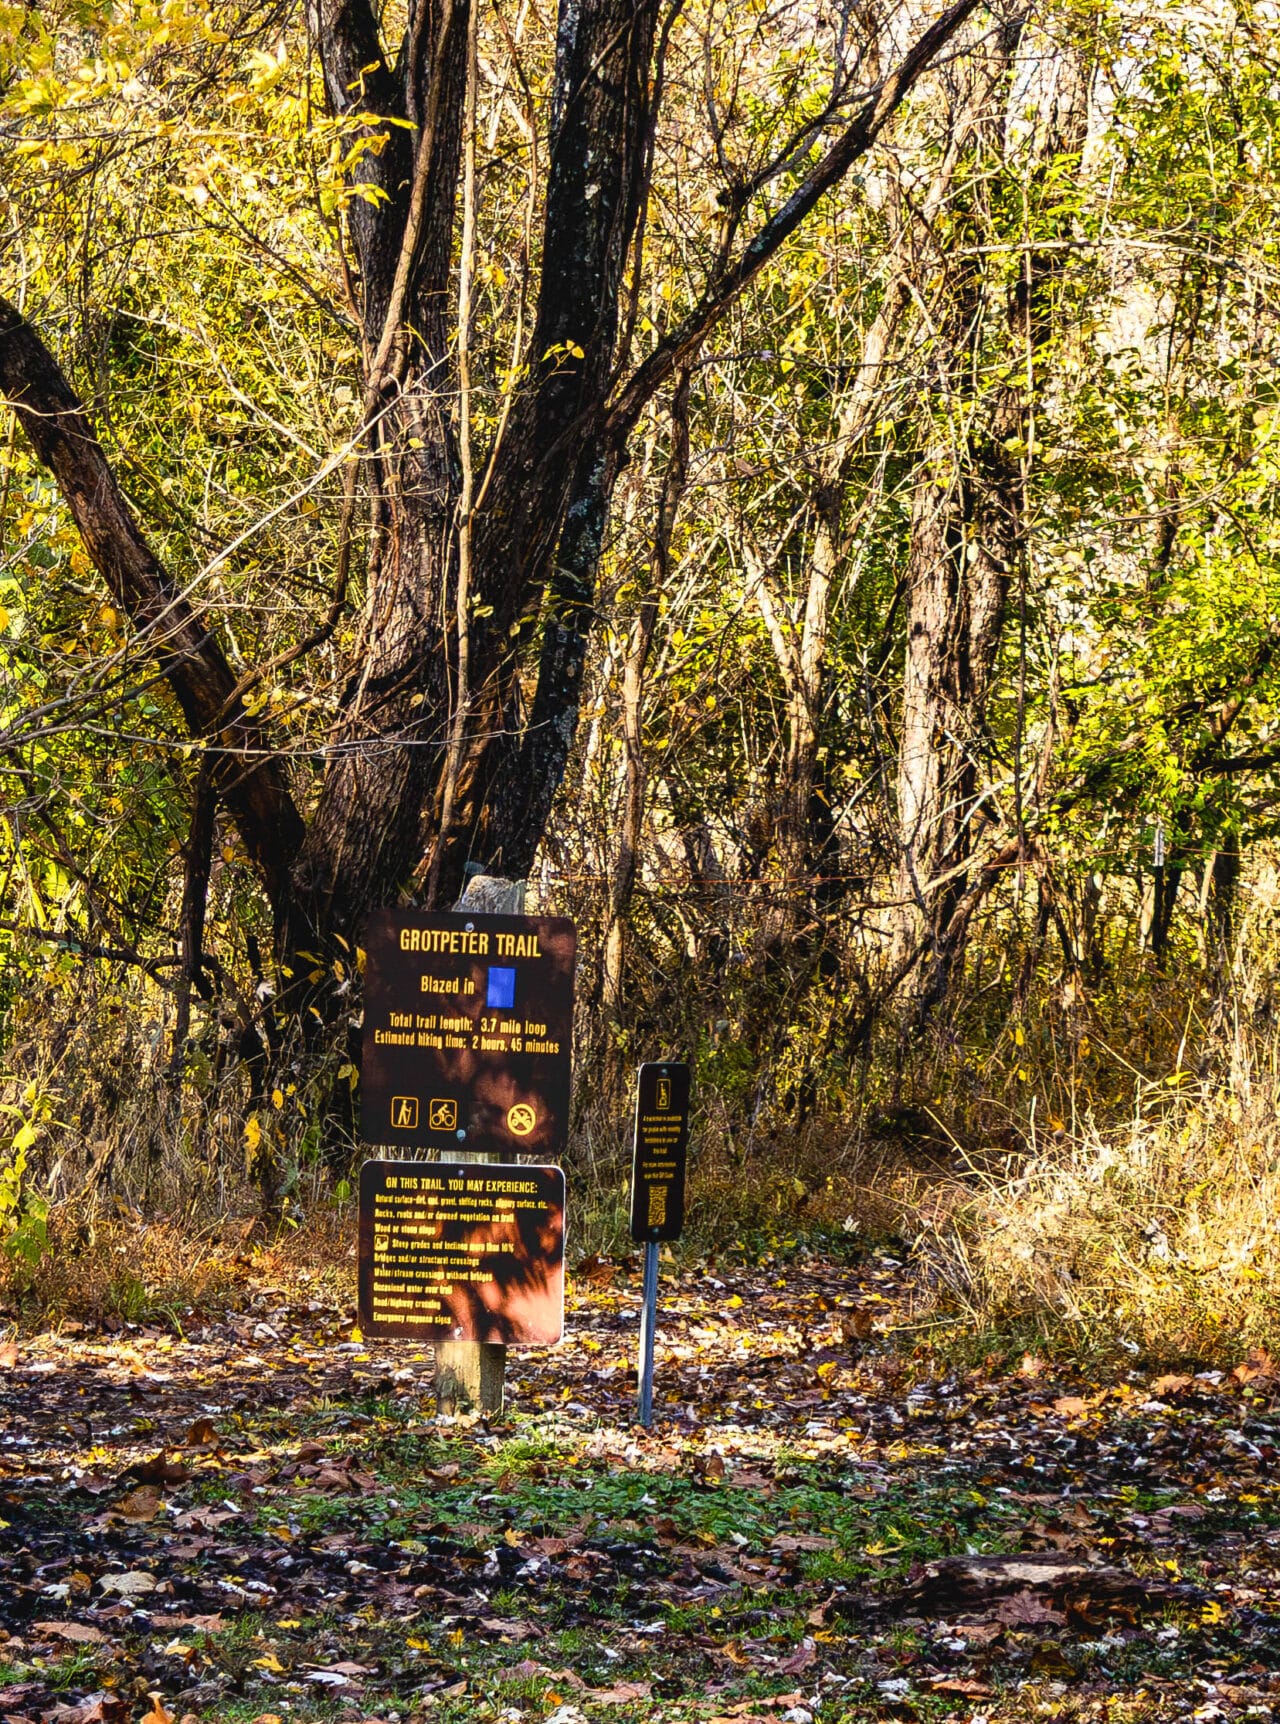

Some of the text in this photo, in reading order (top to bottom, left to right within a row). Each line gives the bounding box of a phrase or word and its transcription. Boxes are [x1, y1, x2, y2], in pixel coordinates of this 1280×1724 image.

[400, 929, 542, 958] GROTPETER TRAIL
[421, 975, 475, 995] Blazed in
[389, 1012, 547, 1037] Total trail length: 3.7 mile loop
[375, 1030, 559, 1054] Estimated hiking time: 2 hours, 45 minutes
[386, 1176, 398, 1188] ON
[400, 1177, 418, 1189] THIS
[448, 1179, 464, 1191] YOU
[467, 1180, 484, 1192] MAY
[486, 1180, 538, 1193] EXPERIENCE:
